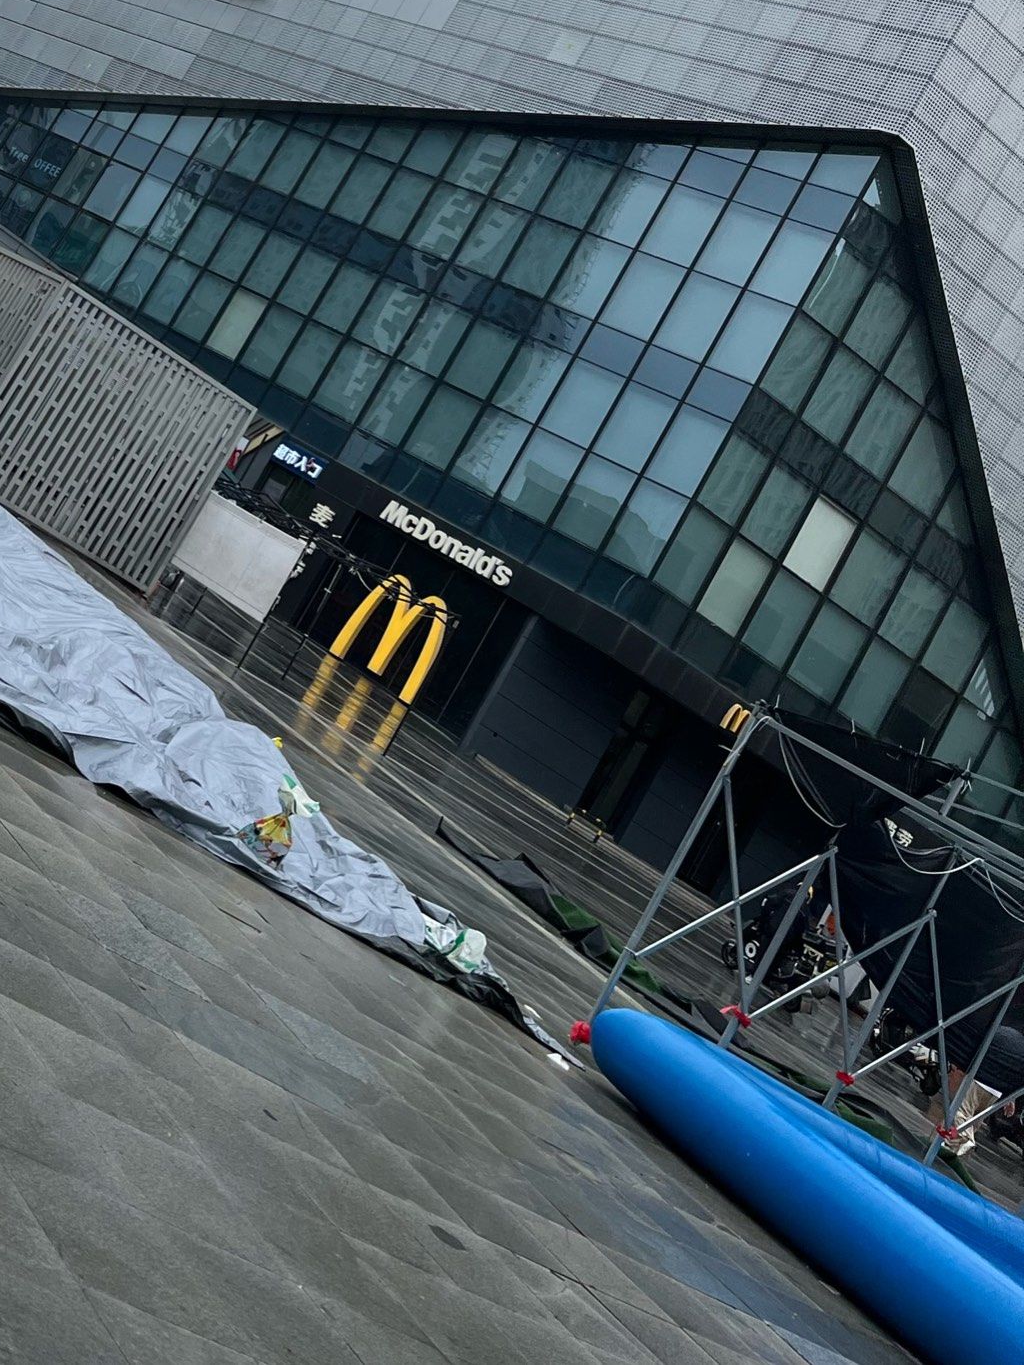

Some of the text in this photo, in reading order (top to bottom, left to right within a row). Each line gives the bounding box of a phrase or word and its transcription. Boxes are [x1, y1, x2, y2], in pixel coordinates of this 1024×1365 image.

[34, 158, 63, 178] OFFEE
[272, 443, 324, 479] 超市入口
[379, 499, 513, 587] McDonald's
